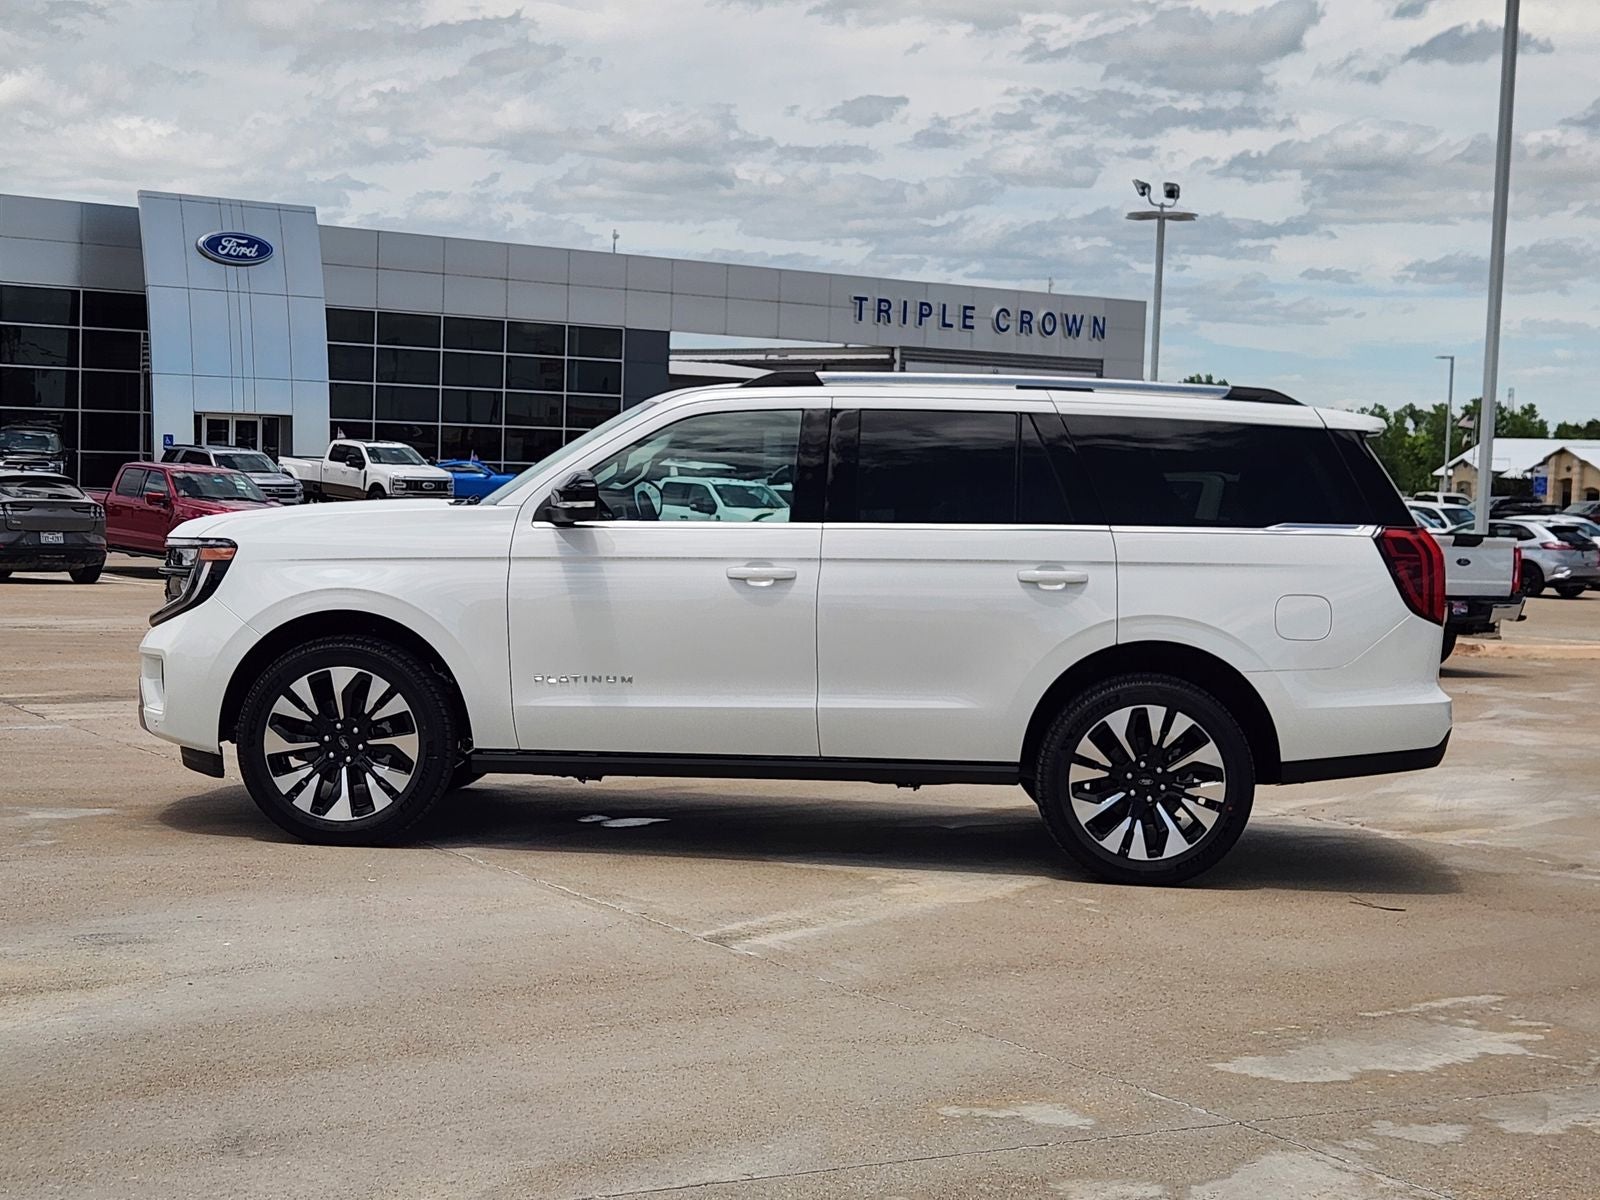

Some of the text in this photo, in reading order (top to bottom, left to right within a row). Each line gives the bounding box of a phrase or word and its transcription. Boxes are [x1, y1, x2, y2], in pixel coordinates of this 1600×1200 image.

[217, 237, 259, 257] Ford
[852, 295, 1106, 340] TRIPLE CROWN
[533, 674, 634, 684] PLATINUM
